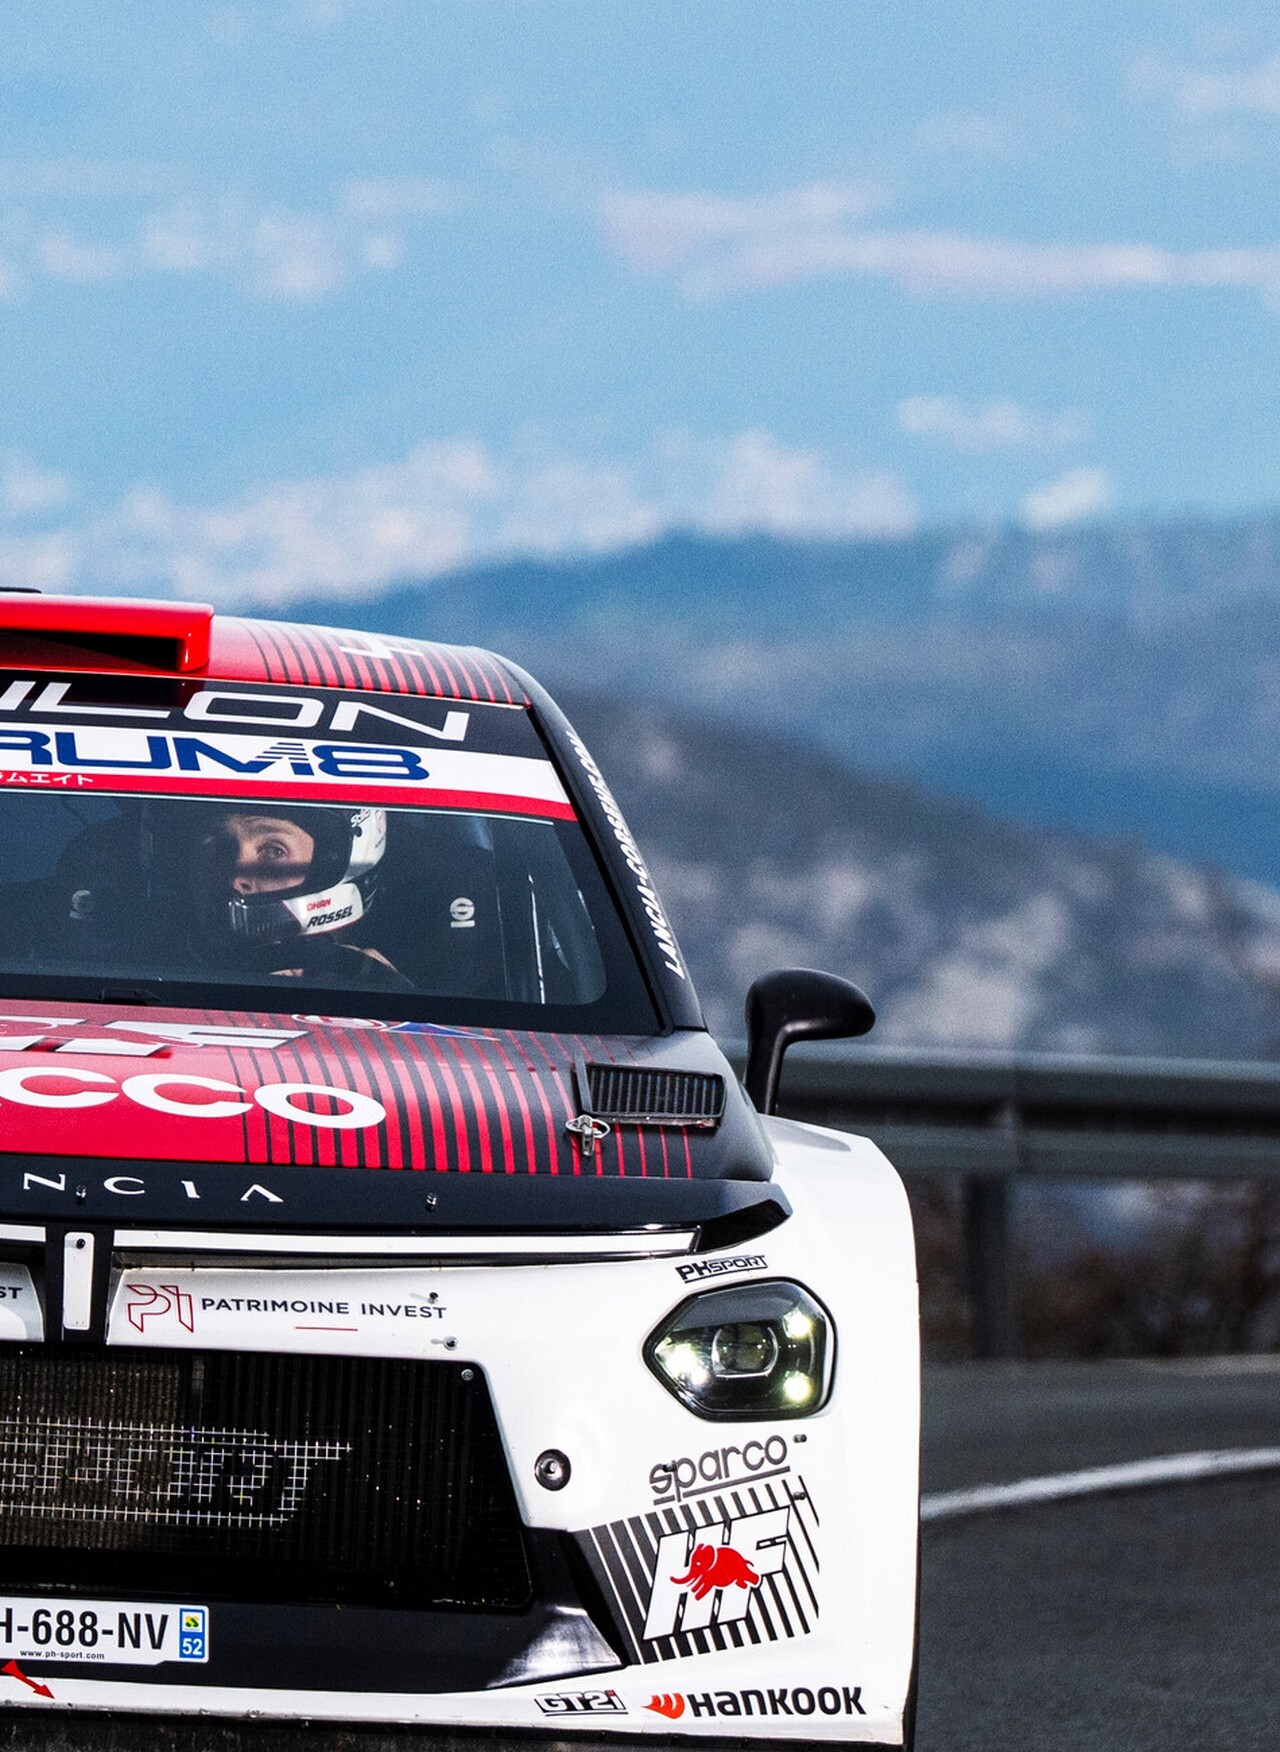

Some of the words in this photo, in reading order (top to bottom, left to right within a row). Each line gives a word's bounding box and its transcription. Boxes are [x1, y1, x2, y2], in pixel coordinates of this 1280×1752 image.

[307, 905, 353, 928] ROSSEL
[202, 1298, 350, 1315] PATRIMOINE
[361, 1303, 448, 1319] INVEST
[649, 1434, 788, 1501] sparco
[19, 1649, 106, 1661] www.ph-sport.com
[182, 1639, 203, 1656] 52
